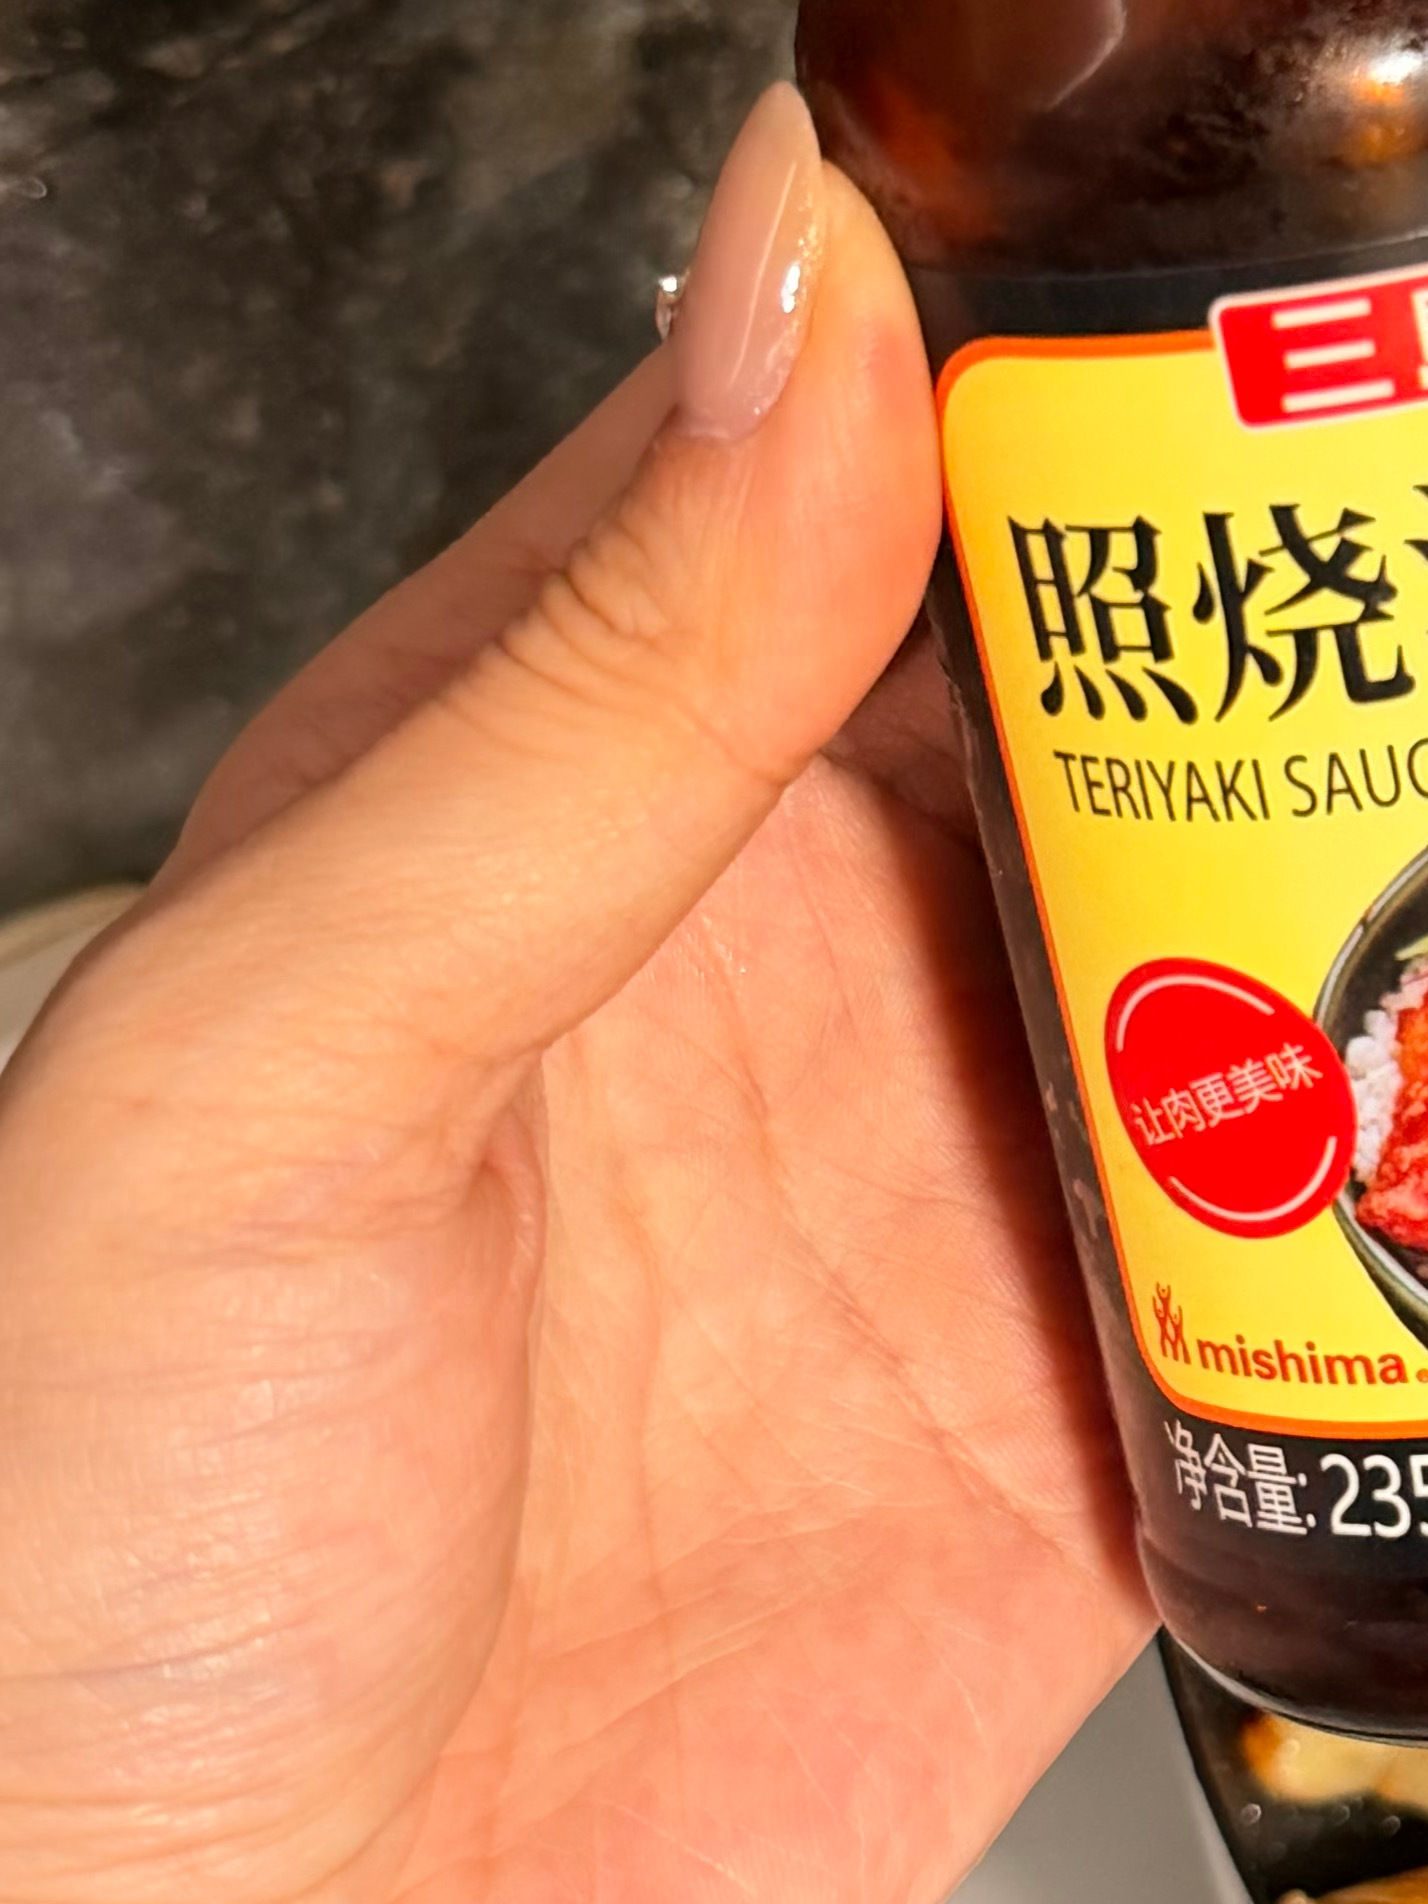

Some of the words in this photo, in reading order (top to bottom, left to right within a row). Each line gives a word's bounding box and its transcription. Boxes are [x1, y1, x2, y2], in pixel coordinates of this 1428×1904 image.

[1053, 749, 1270, 823] TERIYAKI
[1130, 1042, 1324, 1146] 让肉更美味
